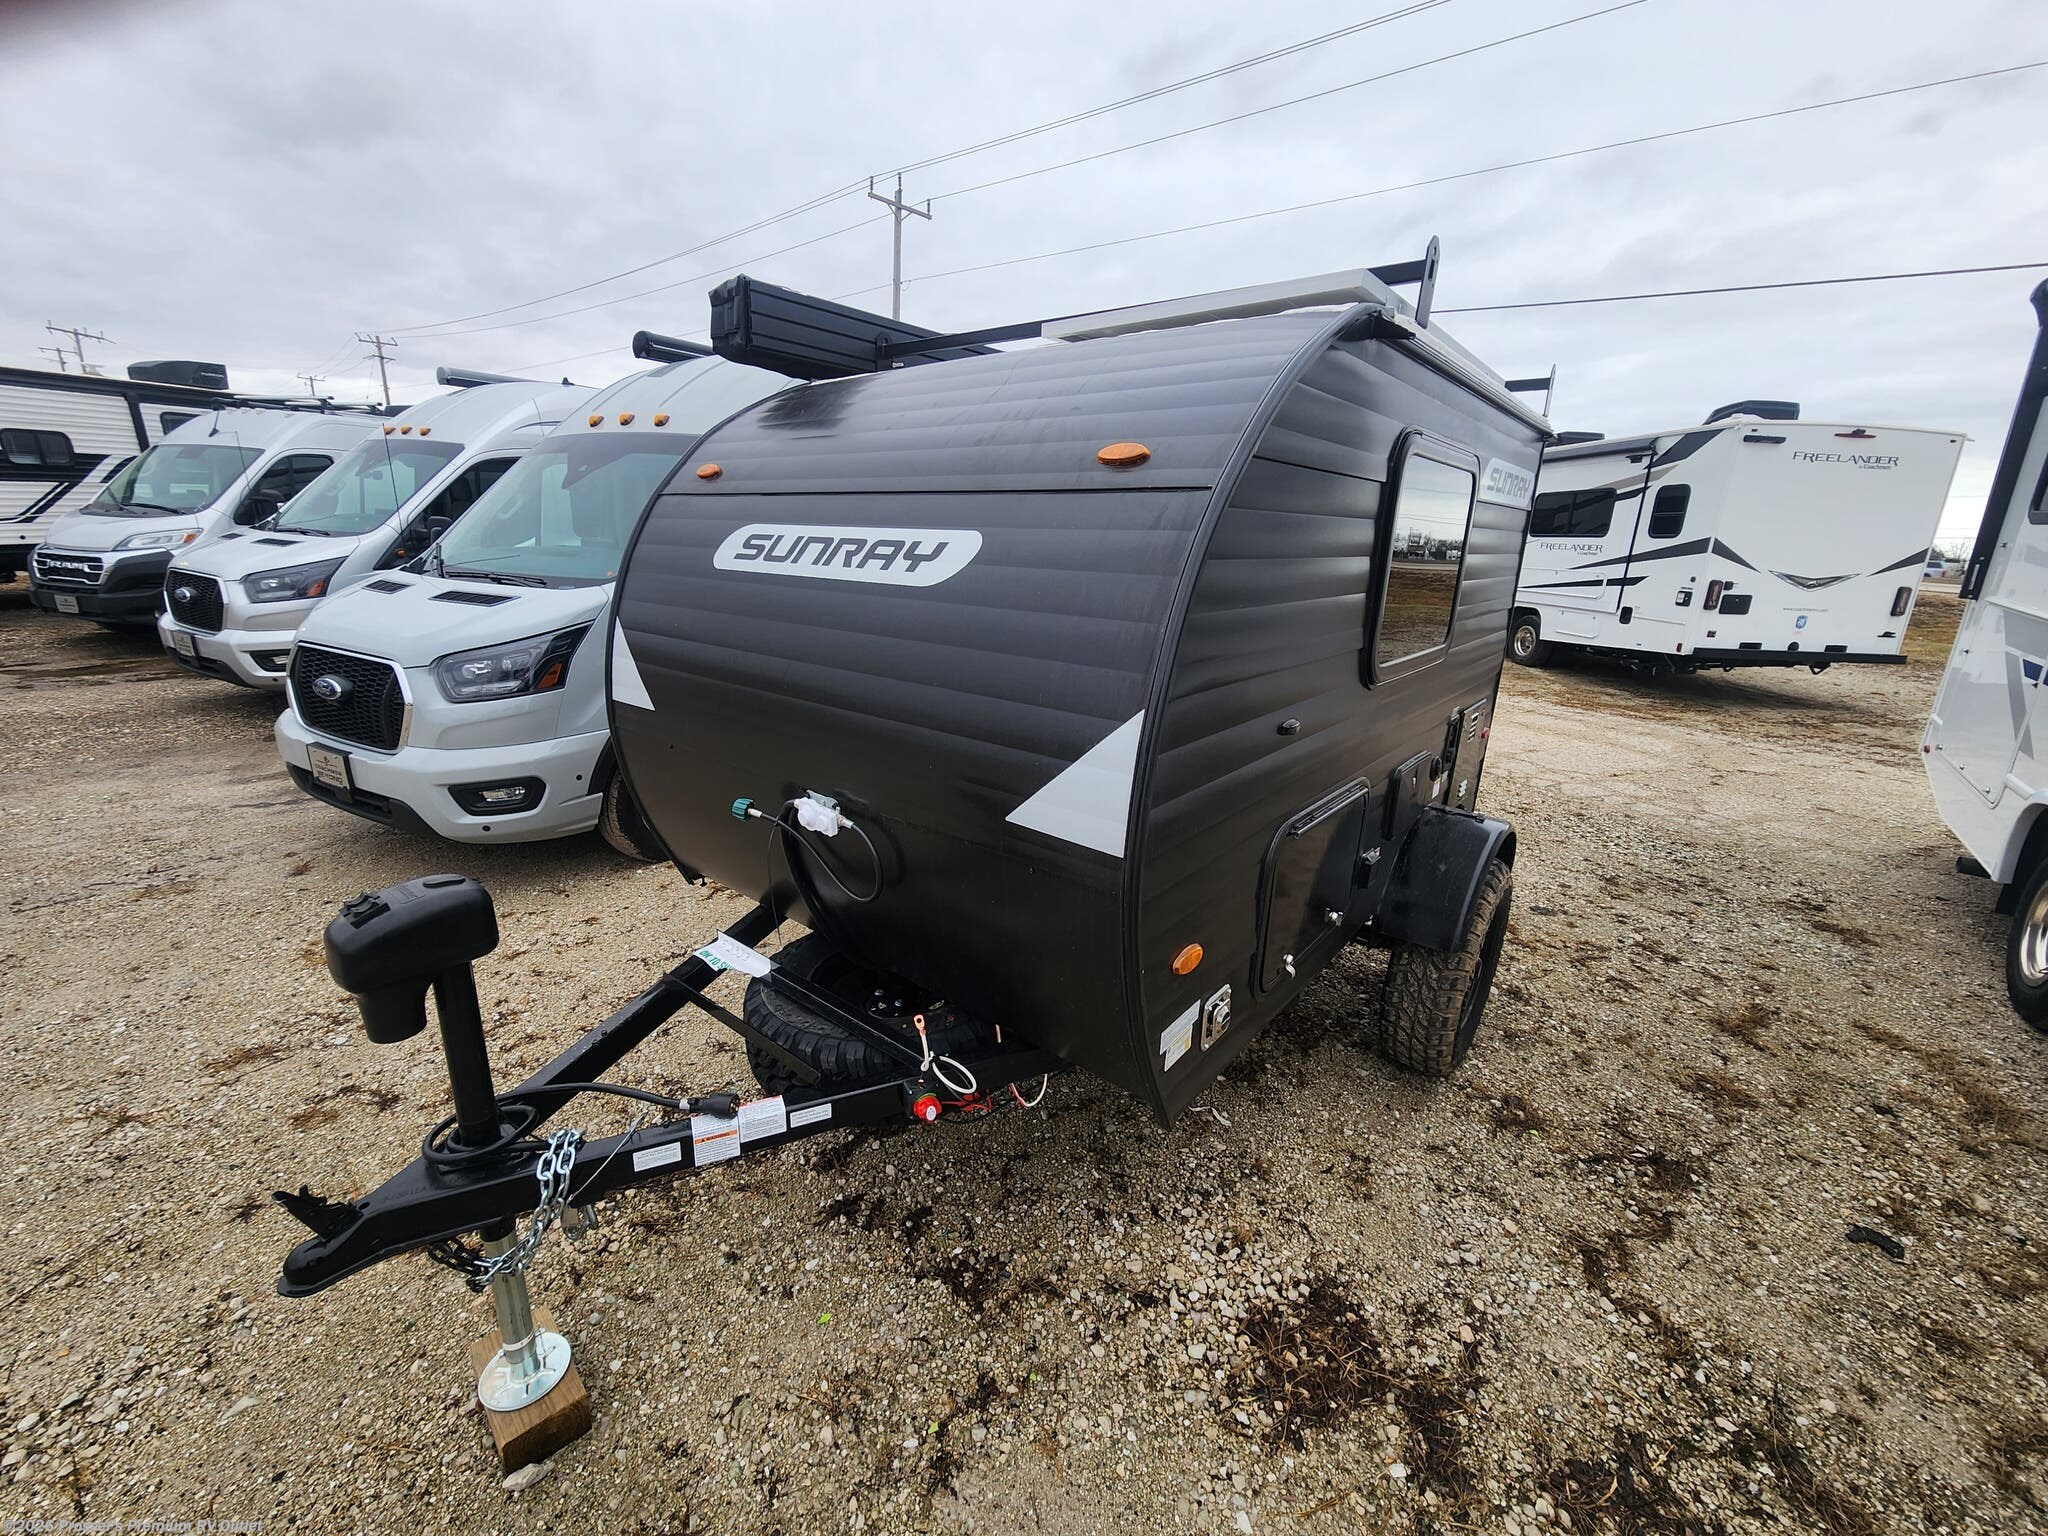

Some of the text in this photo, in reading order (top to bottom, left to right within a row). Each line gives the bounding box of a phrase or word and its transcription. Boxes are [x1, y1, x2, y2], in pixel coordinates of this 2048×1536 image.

[1792, 450, 1899, 466] FREELANDER
[1487, 468, 1531, 499] SUNRAY
[734, 534, 949, 572] SUNRAY
[1540, 542, 1603, 554] FREELANDER
[50, 560, 83, 570] RAM
